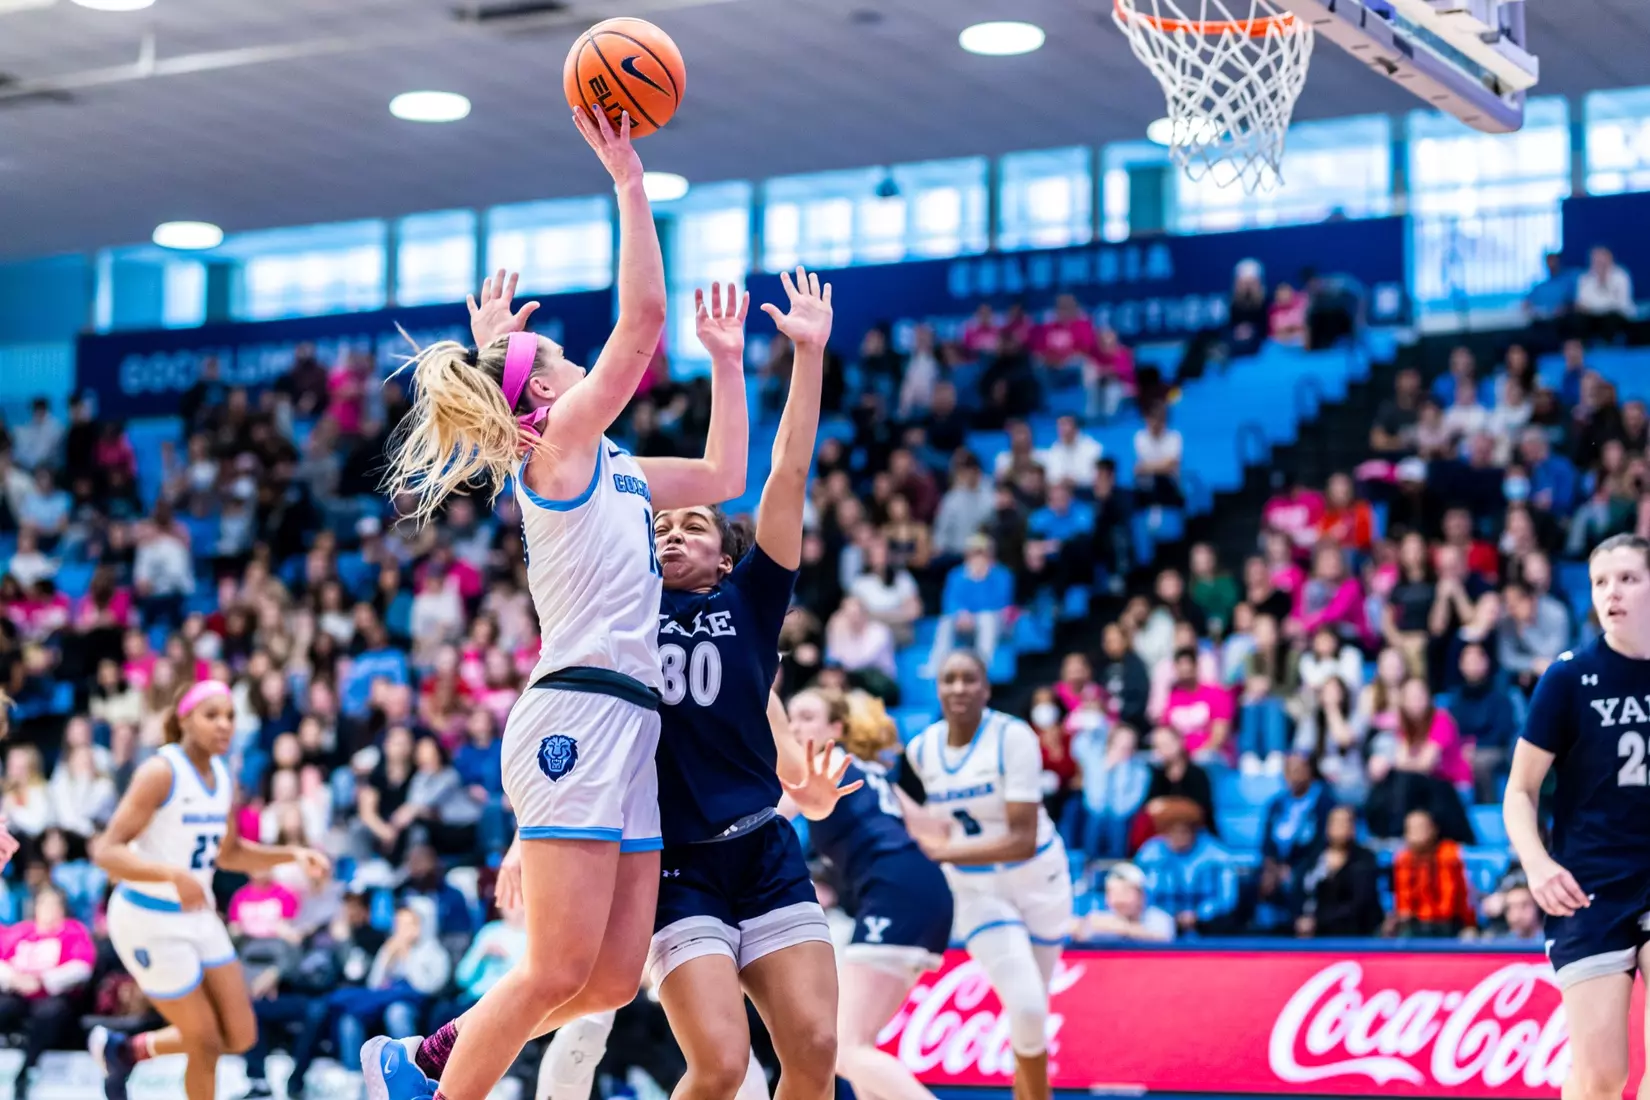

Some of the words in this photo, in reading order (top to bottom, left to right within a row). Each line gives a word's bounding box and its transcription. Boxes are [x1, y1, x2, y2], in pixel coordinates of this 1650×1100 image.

[1590, 695, 1650, 727] YA
[1617, 730, 1650, 787] 2
[863, 916, 891, 942] Y
[1268, 960, 1573, 1087] Coca-Col
